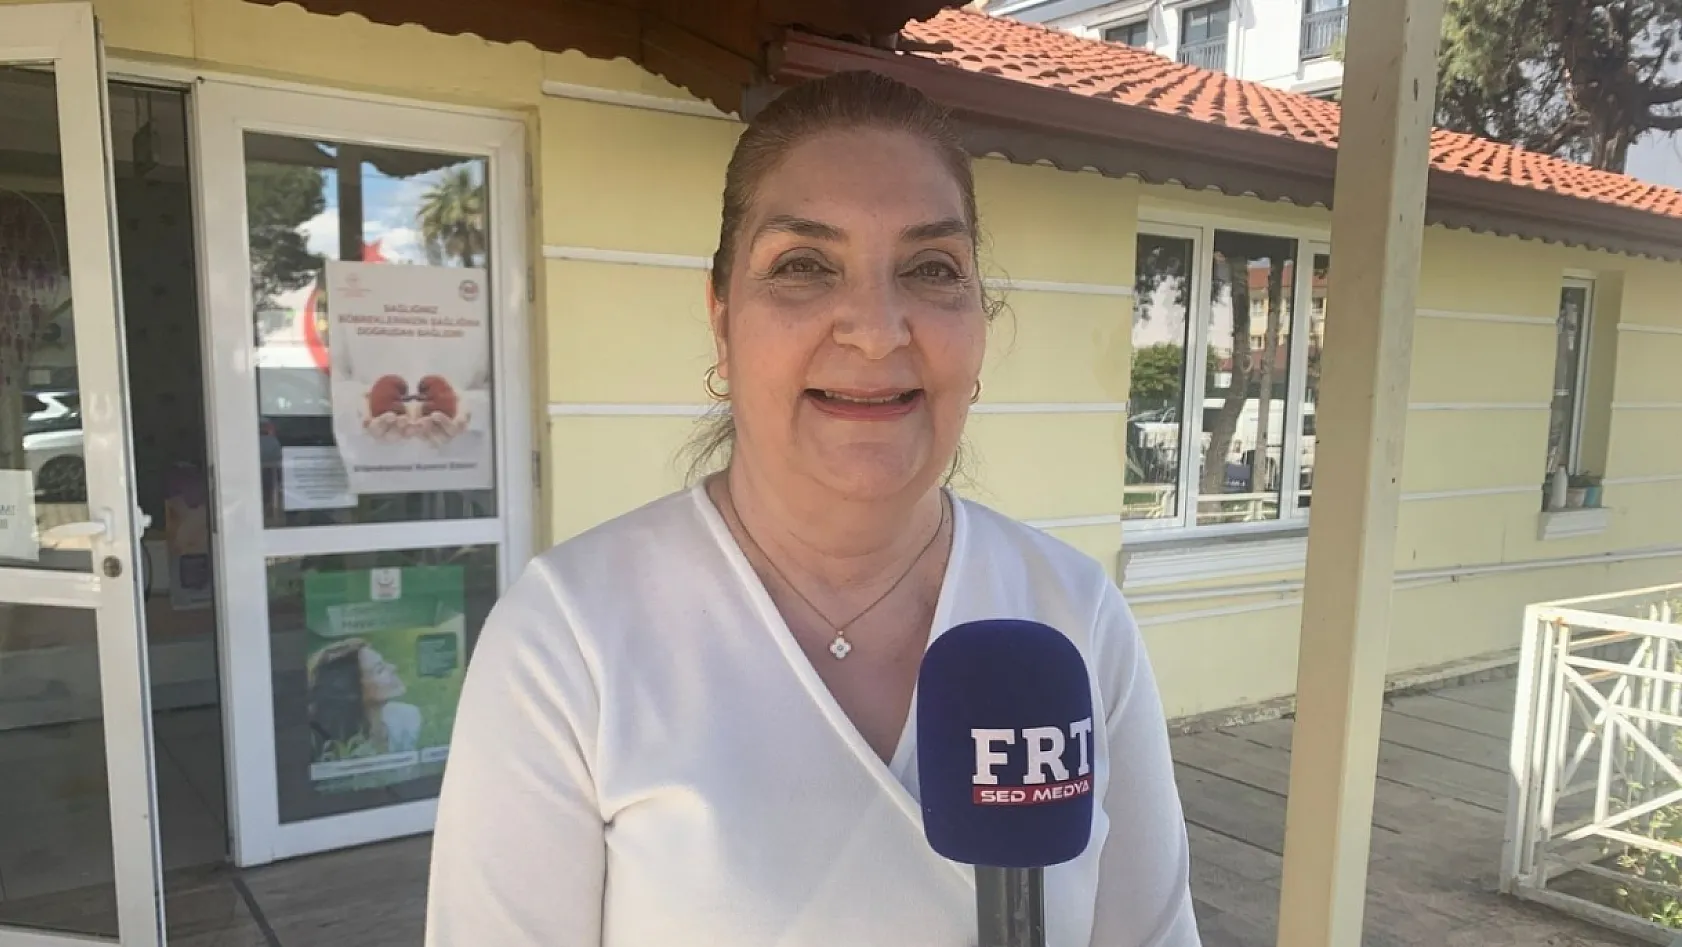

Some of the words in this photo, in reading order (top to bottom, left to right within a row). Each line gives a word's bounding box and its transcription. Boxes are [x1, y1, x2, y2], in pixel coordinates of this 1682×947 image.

[970, 717, 1092, 785] FRT
[980, 790, 1026, 803] SED
[1032, 779, 1090, 802] MEDYA
